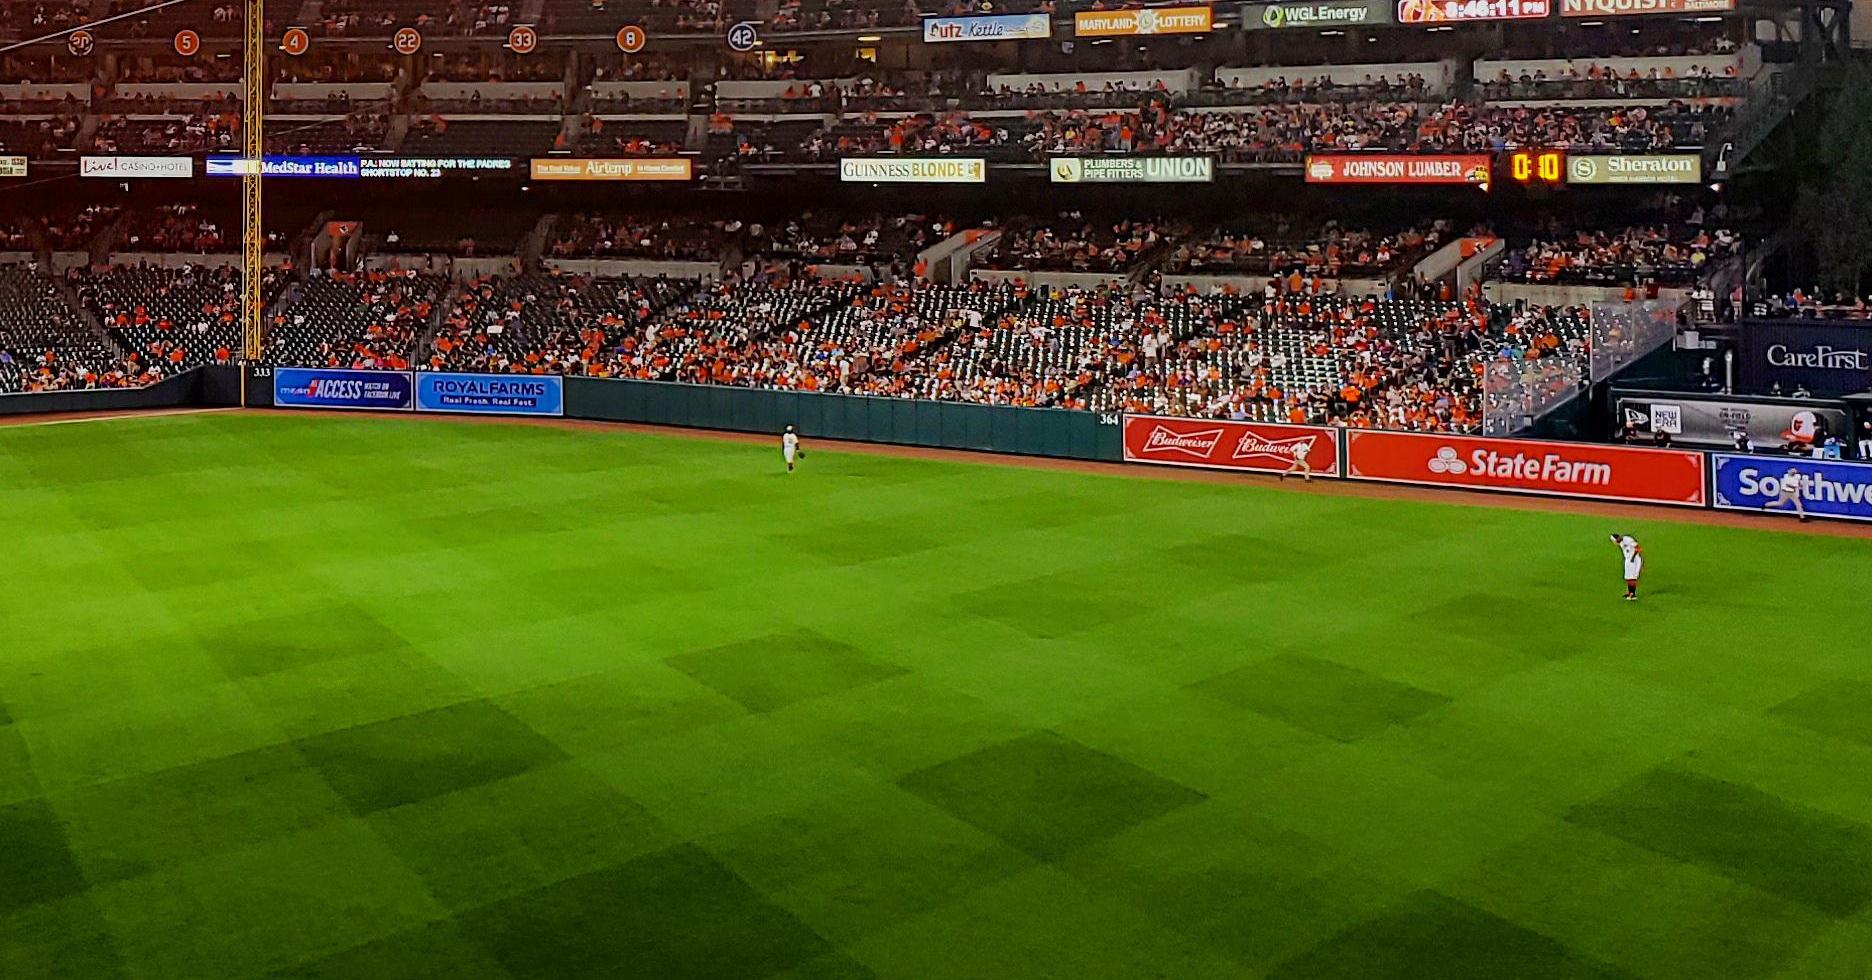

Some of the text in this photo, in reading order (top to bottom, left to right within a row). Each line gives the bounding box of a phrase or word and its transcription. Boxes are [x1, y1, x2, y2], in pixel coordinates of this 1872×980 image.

[1522, 1, 1545, 14] PM
[968, 21, 1004, 38] Kettle
[1079, 15, 1205, 30] MARYLAND LOTTERY
[182, 35, 192, 49] 5
[289, 34, 299, 49] 4
[398, 33, 417, 48] 22
[513, 32, 533, 47] 33
[625, 31, 636, 46] 8
[731, 29, 752, 45] 42
[261, 160, 358, 175] MedStar Health
[378, 160, 400, 168] NOW
[400, 160, 437, 168] BATTING
[437, 160, 456, 168] FOR
[457, 160, 475, 168] THE
[476, 160, 512, 169] PADRES
[585, 161, 632, 177] Airtemp
[843, 162, 964, 177] GUINNESS BLONDE
[1083, 159, 1143, 169] PLUMBERS &
[1145, 157, 1211, 178] UNION
[1342, 161, 1404, 178] JOHNSON
[1407, 161, 1461, 178] LUMBER
[1608, 156, 1692, 173] Sheraton
[360, 168, 413, 177] SHORTSTOP
[1083, 168, 1144, 179] PIPE FITTERS
[1767, 344, 1869, 371] CareFirst
[315, 379, 362, 400] ACCESS
[443, 396, 463, 404] Real
[492, 397, 511, 406] Real
[1099, 414, 1119, 425] 364
[1655, 409, 1677, 419] NEW
[1150, 430, 1214, 449] Budweiser
